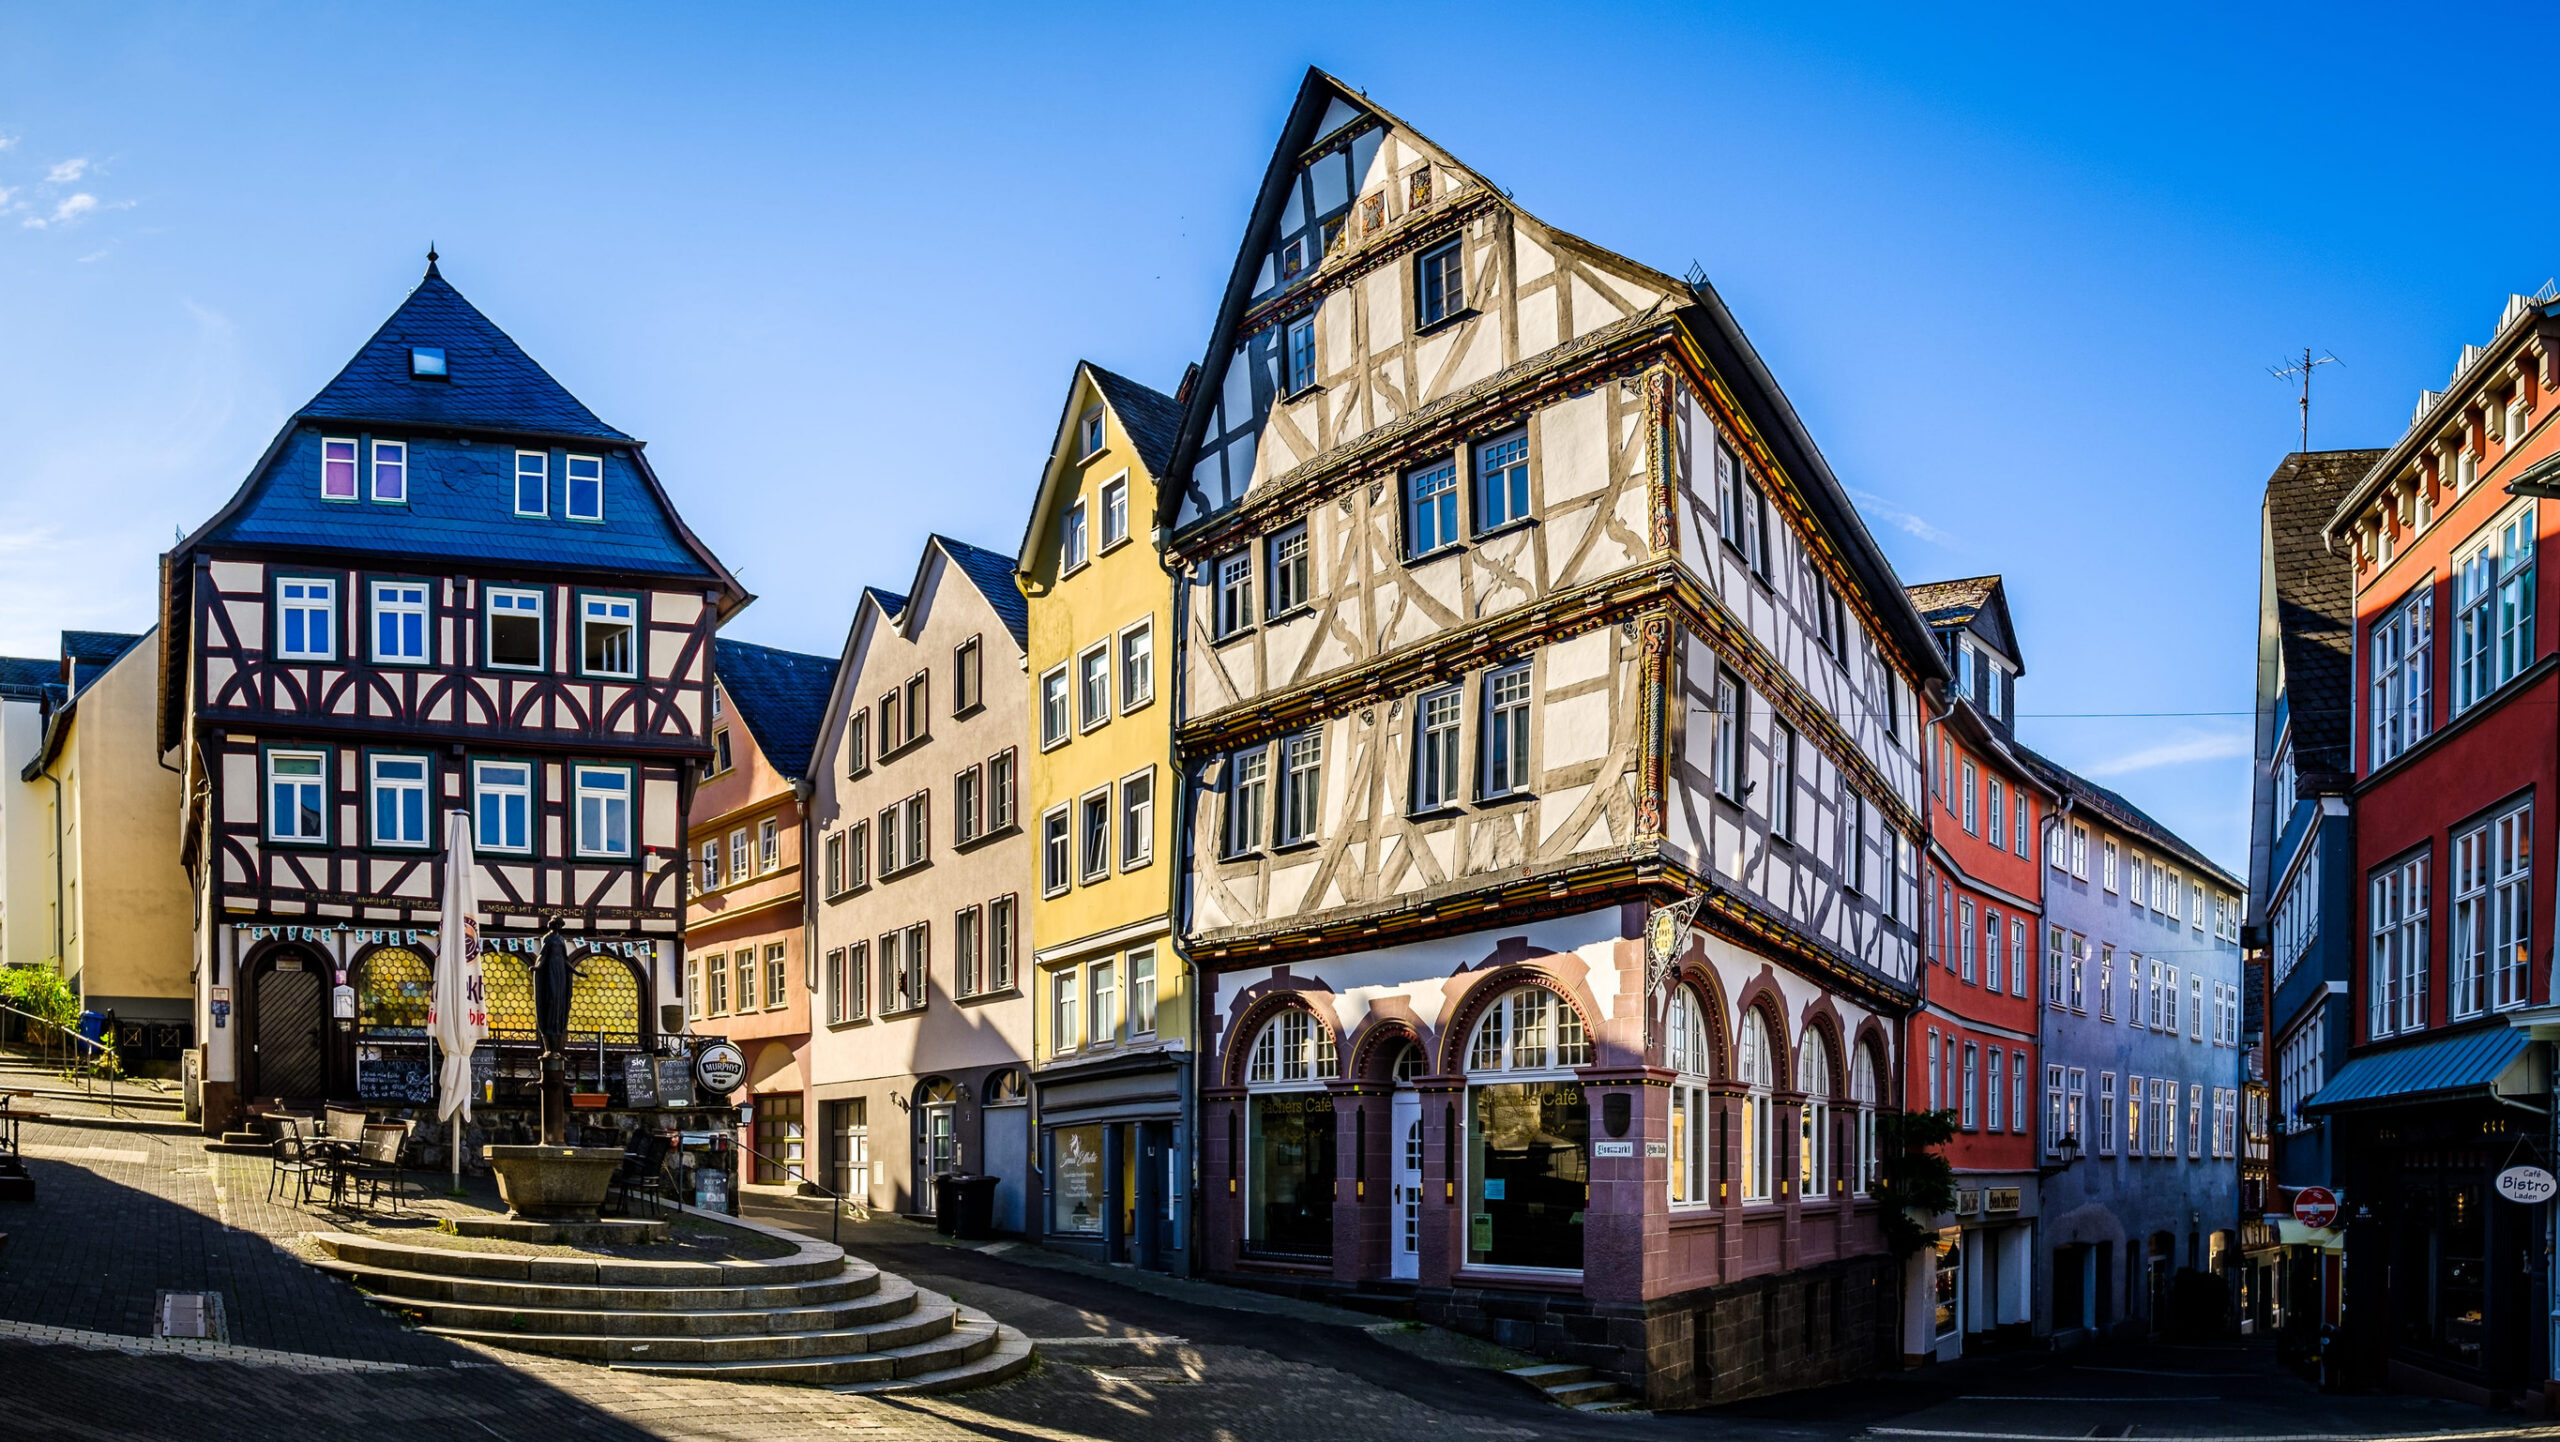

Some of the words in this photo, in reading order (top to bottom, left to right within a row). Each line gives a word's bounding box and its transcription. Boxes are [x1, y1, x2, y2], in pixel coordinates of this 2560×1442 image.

[407, 899, 439, 909] FREUDE
[482, 904, 516, 913] UMGANG
[519, 906, 532, 914] MIT
[538, 907, 587, 917] MENSCHEN
[631, 1057, 646, 1067] sky
[1305, 1096, 1332, 1113] Café
[1542, 1087, 1578, 1106] Café
[2523, 1169, 2541, 1178] Café
[2502, 1176, 2550, 1193] Bistro
[2514, 1191, 2538, 1200] Laden
